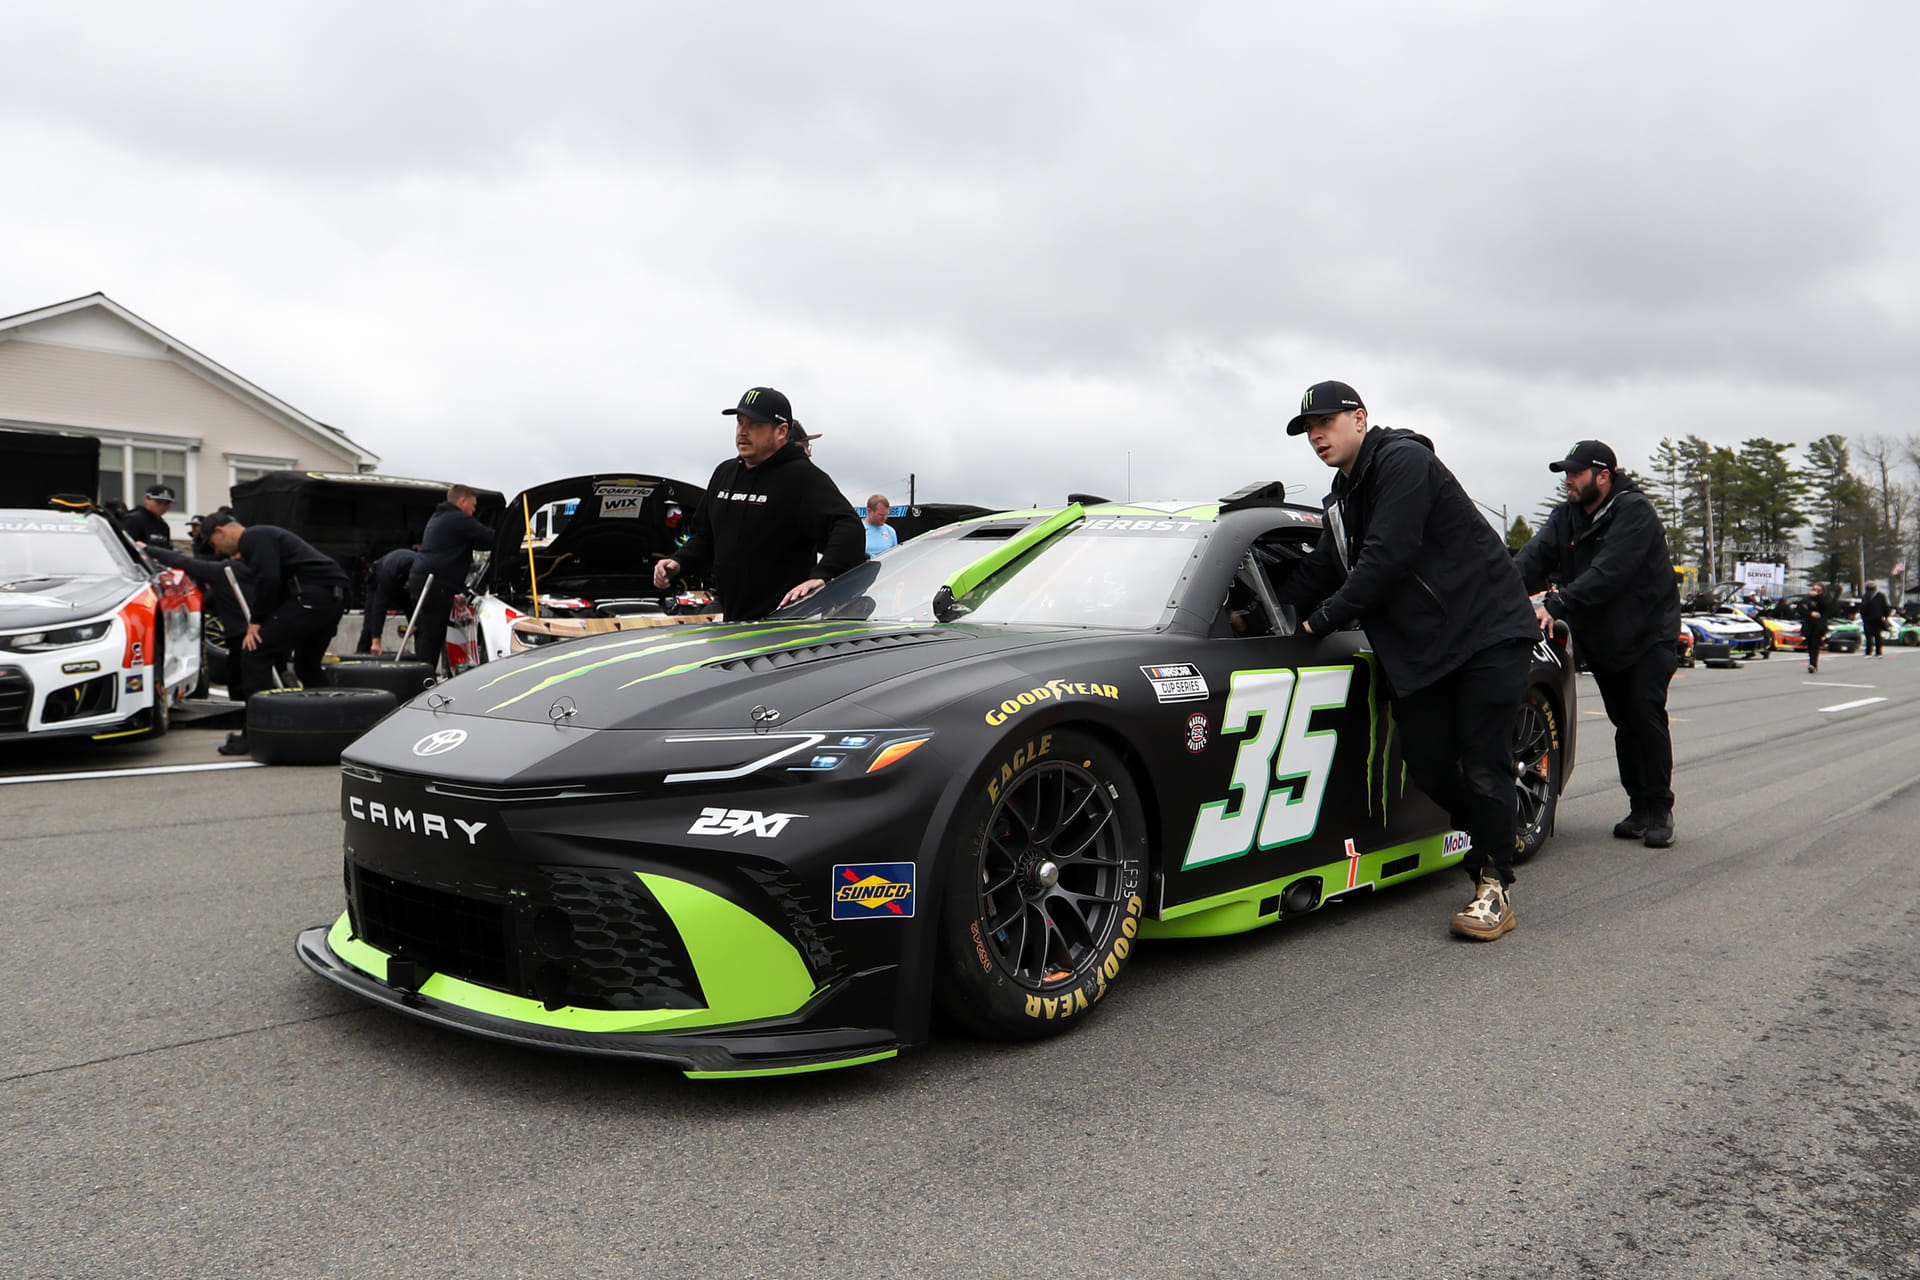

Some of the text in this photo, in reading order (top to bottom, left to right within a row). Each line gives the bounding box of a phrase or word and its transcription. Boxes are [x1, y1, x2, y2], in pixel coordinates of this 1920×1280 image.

[604, 498, 638, 510] WIX
[1066, 518, 1201, 532] HERBST
[1161, 680, 1200, 693] CUP SERIES
[1162, 666, 1192, 678] NASCAR
[985, 679, 1119, 726] GOODYEAR
[1542, 701, 1560, 750] EAGLE
[987, 734, 1052, 805] EAGLE
[1181, 665, 1355, 872] 35
[350, 796, 488, 844] CAMRY
[839, 885, 908, 900] SUNOCO
[1025, 896, 1143, 1019] GOODYEAR
